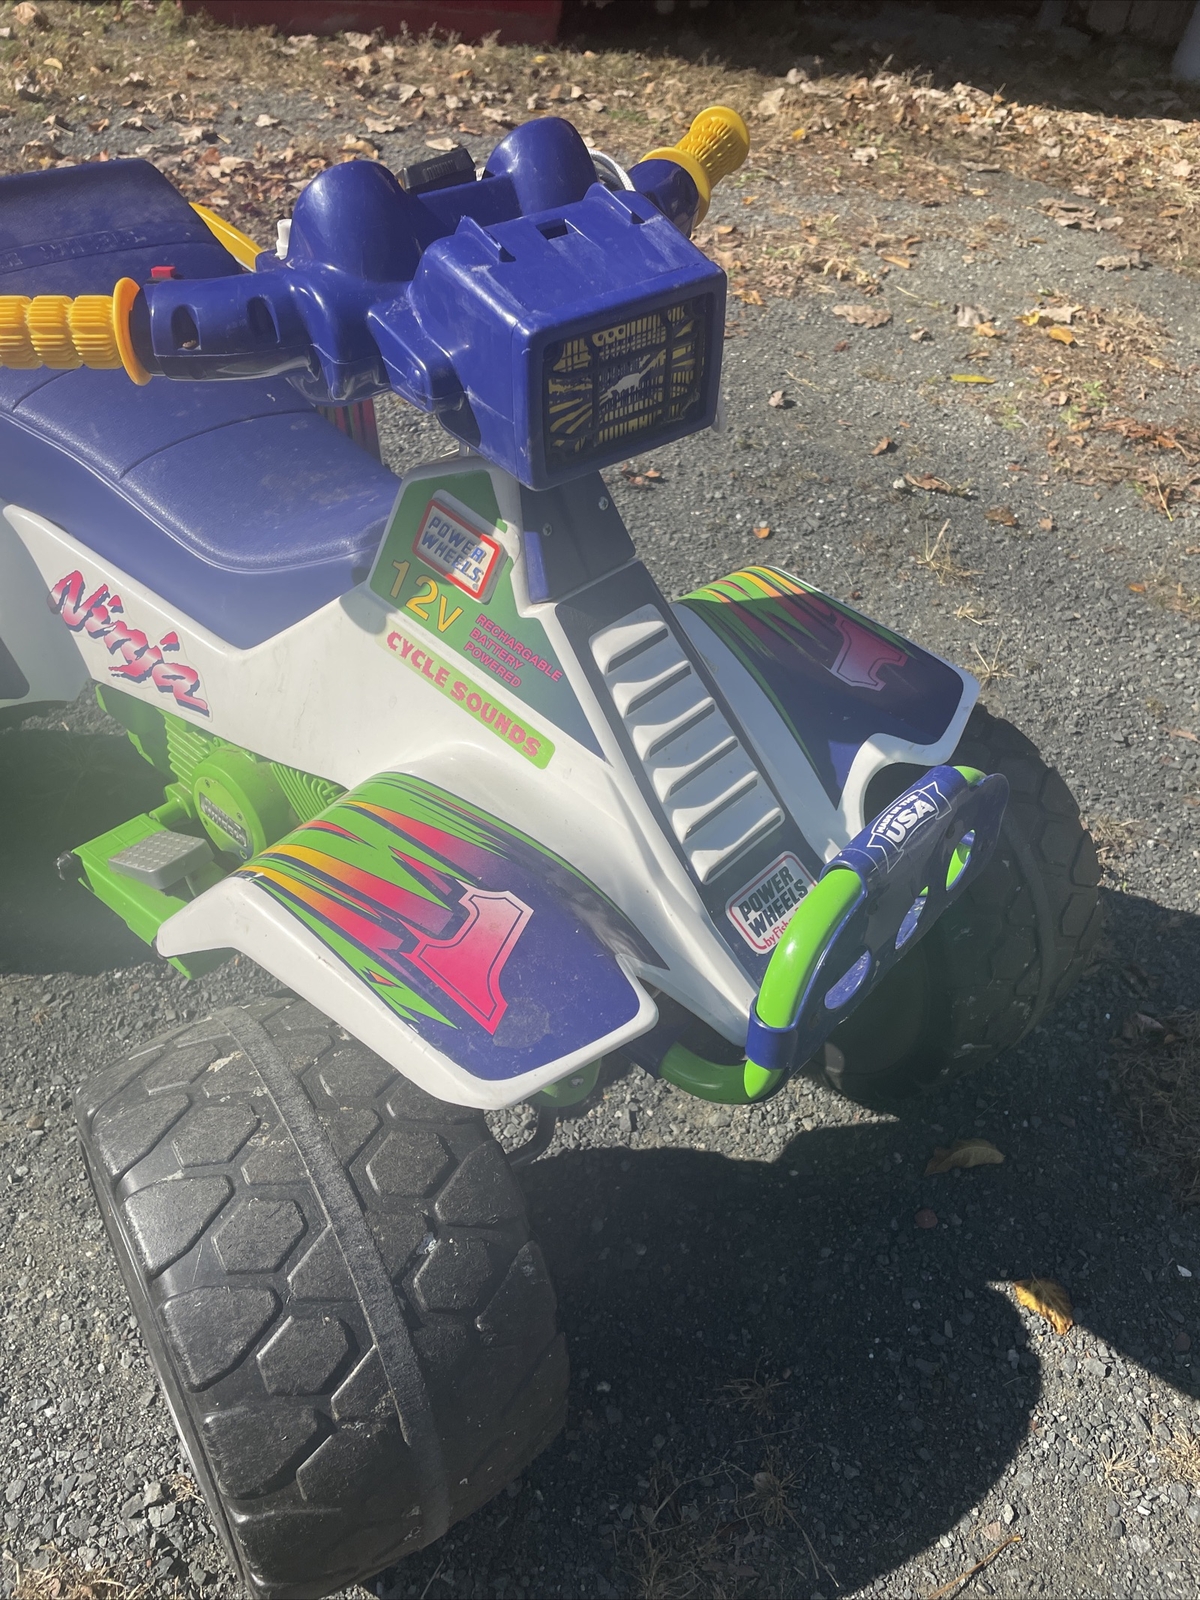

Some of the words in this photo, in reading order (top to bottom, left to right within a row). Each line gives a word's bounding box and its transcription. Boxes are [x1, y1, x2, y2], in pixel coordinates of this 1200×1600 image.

[421, 531, 483, 583] WHEELS
[428, 516, 487, 563] POWER
[390, 559, 463, 632] 12V
[48, 570, 210, 717] Ninja
[463, 641, 521, 688] POWERED
[470, 628, 525, 670] BATTERY
[475, 614, 562, 682] RECHARGABLE
[387, 631, 450, 688] CYCLE
[450, 681, 541, 757] SOUNDS
[885, 799, 936, 843] USA
[738, 866, 794, 922] POWER
[748, 879, 808, 938] WHEELS
